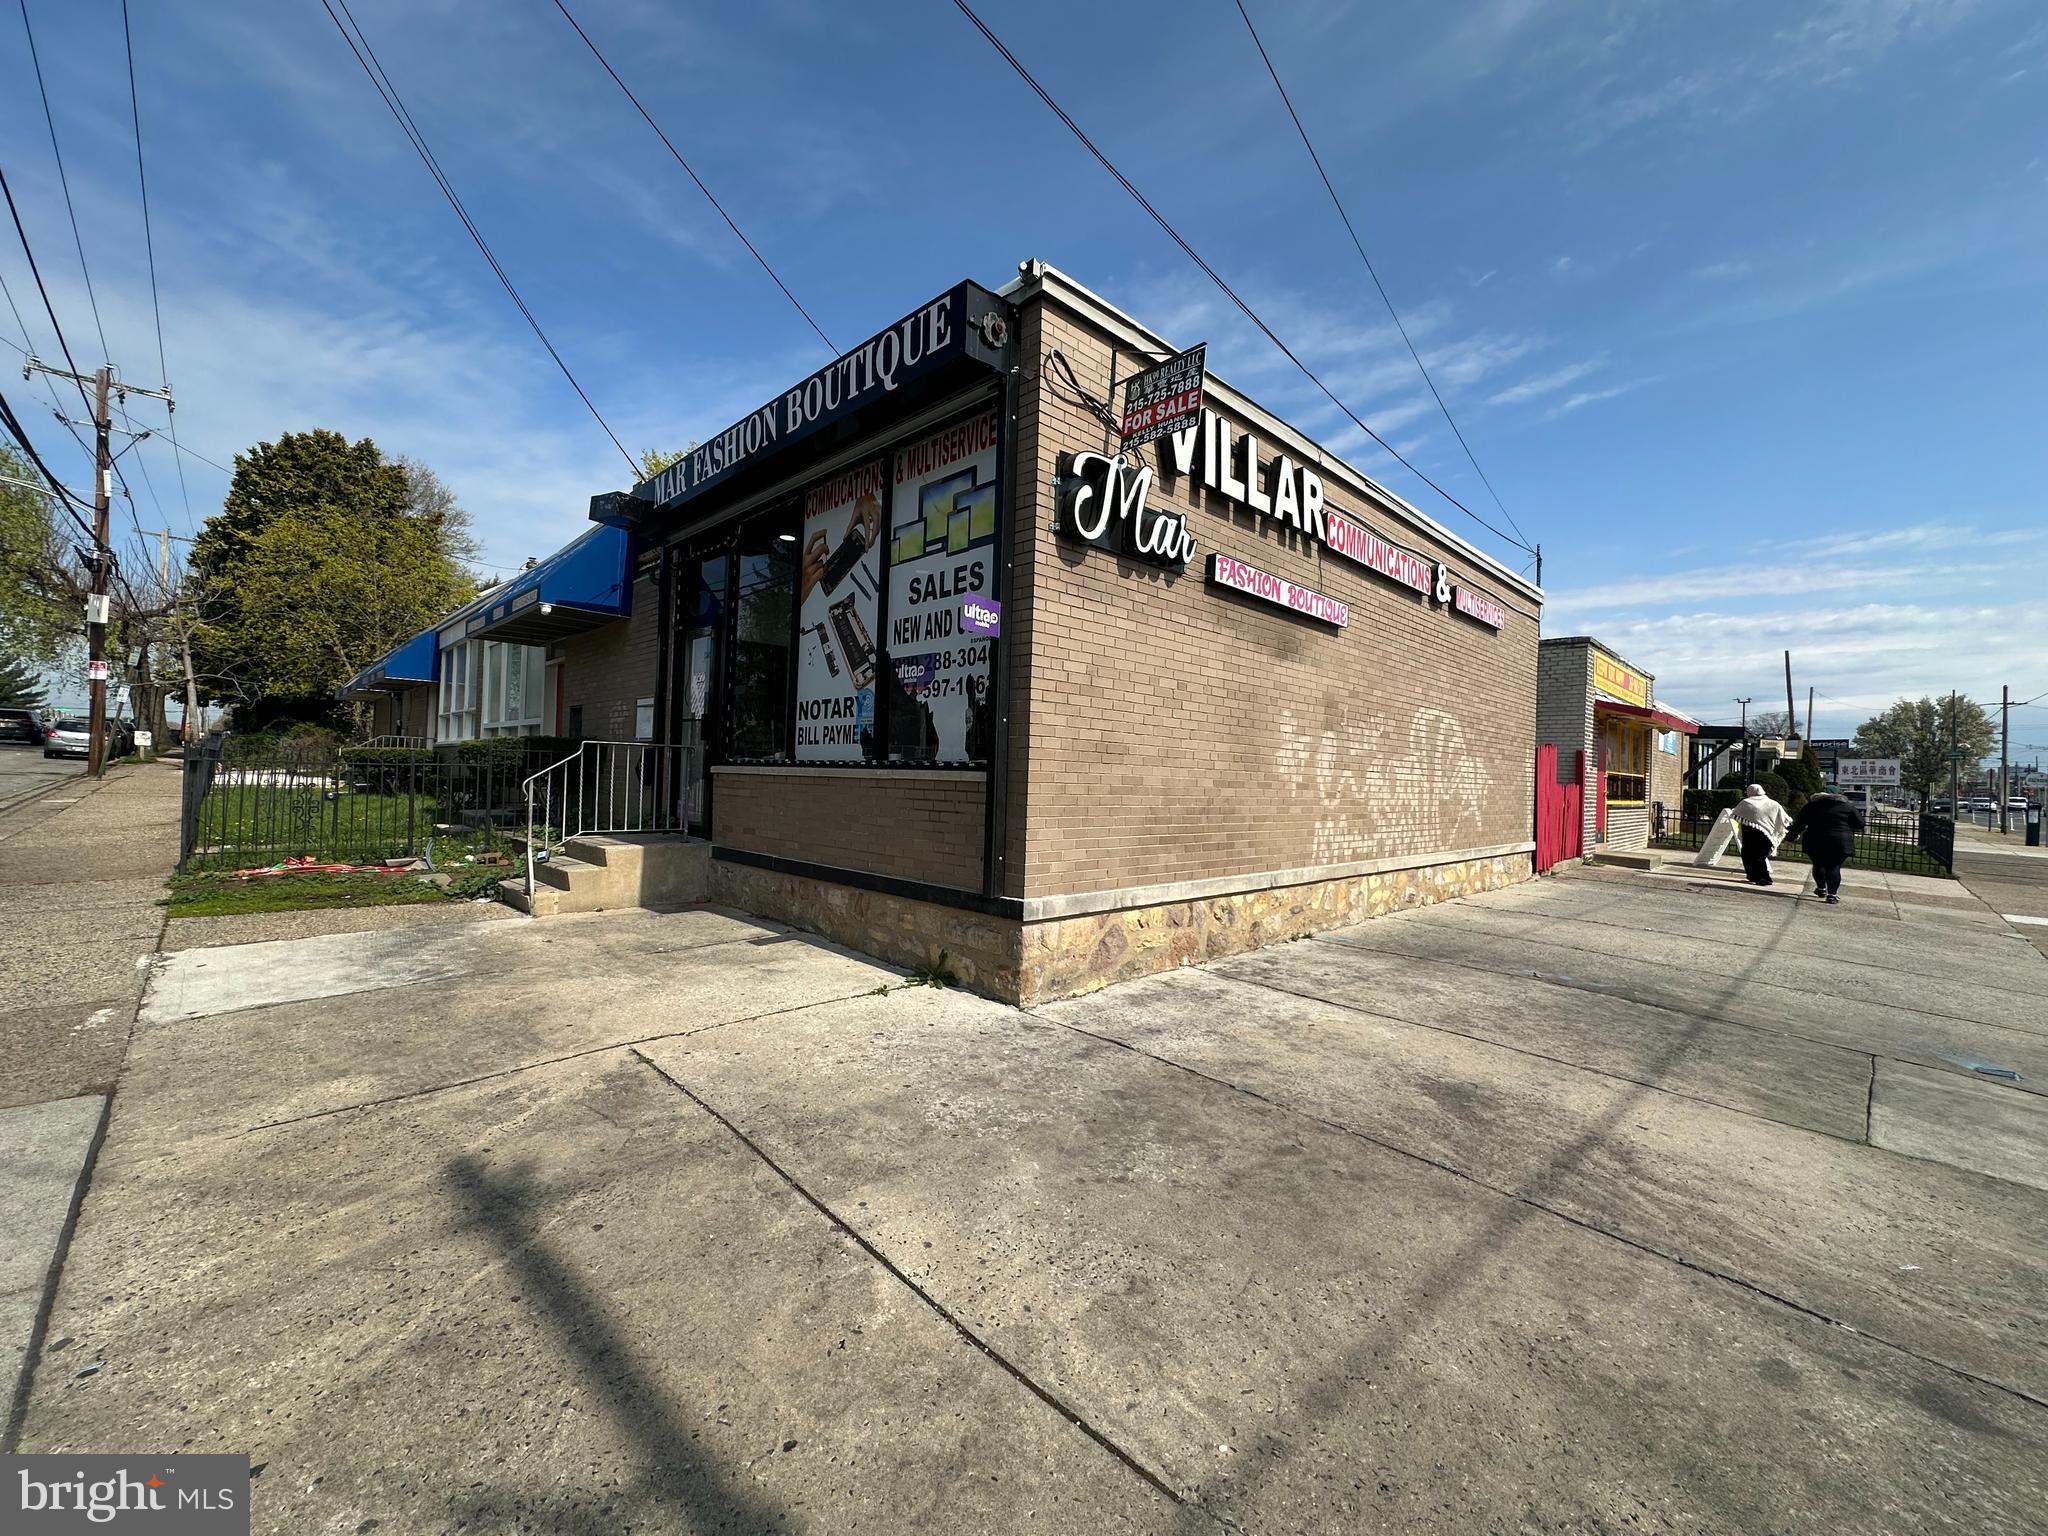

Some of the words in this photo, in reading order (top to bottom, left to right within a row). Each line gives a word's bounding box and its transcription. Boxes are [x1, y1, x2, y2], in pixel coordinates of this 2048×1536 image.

[1160, 359, 1185, 379] REALTY
[1187, 351, 1202, 368] LLC
[653, 462, 687, 509] MAR
[692, 401, 779, 488] FASHION
[786, 296, 951, 434] BOUTIQUE
[1124, 409, 1152, 434] FOR
[1156, 391, 1199, 420] SALE
[1127, 375, 1200, 415] 215-725-7888
[1123, 416, 1196, 450] 215-582-5888
[1133, 425, 1154, 438] KELLY
[1158, 414, 1186, 428] HUANG
[895, 452, 904, 485] &
[1172, 407, 1326, 541] VILLAR
[1073, 451, 1198, 564] Mar
[908, 561, 985, 605] SALES
[1217, 557, 1282, 602] FASHION
[1288, 587, 1347, 625] BOUTIQUE
[1327, 514, 1431, 595] COMMUNICATIONS
[1436, 561, 1451, 603] &
[1456, 586, 1505, 630] MULTISERVICES
[893, 615, 921, 646] NEW
[924, 609, 952, 641] AND
[798, 695, 866, 721] NOTARY
[797, 726, 819, 746] BILL
[823, 725, 863, 745] PAYME
[1807, 739, 1848, 750] terprise
